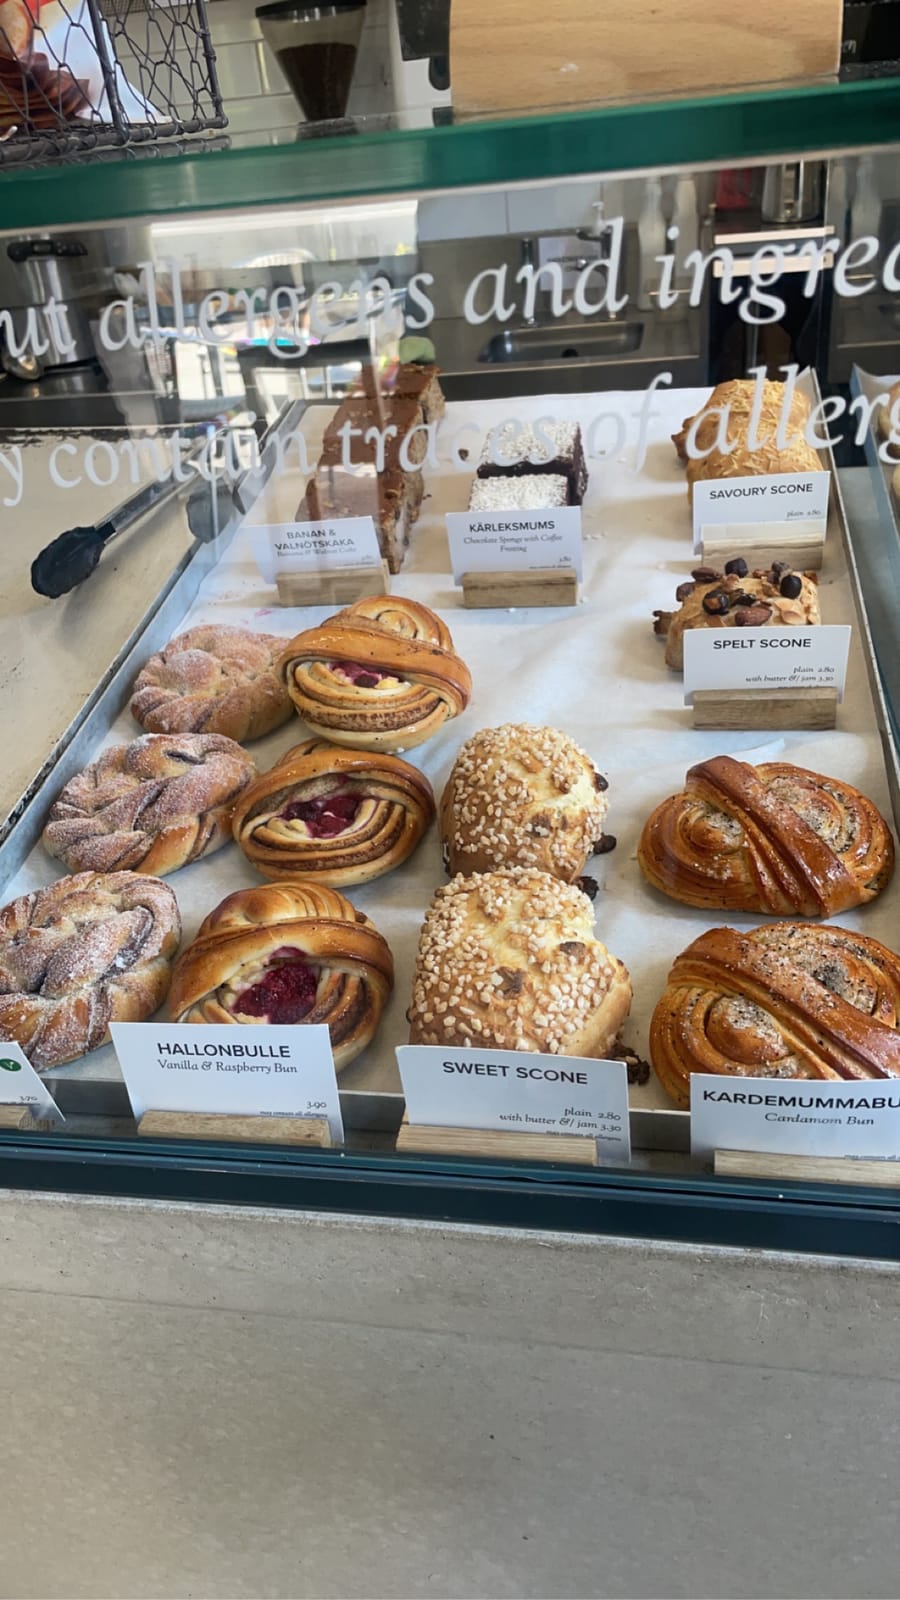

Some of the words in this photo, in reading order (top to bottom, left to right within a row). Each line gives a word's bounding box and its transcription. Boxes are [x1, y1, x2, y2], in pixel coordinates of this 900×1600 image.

[100, 261, 434, 359] allergens
[463, 215, 629, 326] and
[48, 410, 319, 488] contain
[337, 414, 559, 475] traces
[587, 371, 673, 474] of
[709, 486, 767, 500] SAVOURY
[770, 483, 813, 495] SCONE
[286, 529, 326, 540] BANAN
[713, 639, 756, 650] SPELT
[759, 638, 812, 648] SCONE
[764, 674, 787, 682] butter
[793, 666, 814, 674] plain
[157, 1042, 291, 1058] HALLONBULLE
[157, 1059, 199, 1071] Vanilla
[201, 1061, 213, 1071] &
[216, 1061, 271, 1075] Raspberry
[274, 1063, 298, 1073] Bun
[442, 1061, 510, 1077] SWEET
[516, 1067, 588, 1084] SCONE
[306, 1101, 327, 1109] 3.90
[703, 1090, 900, 1109] KARDEMUMMABU
[564, 1107, 592, 1118] plain
[597, 1111, 622, 1121] 2.80
[764, 1112, 843, 1125] Cardamom
[846, 1115, 874, 1126] Bun
[499, 1113, 523, 1123] with
[525, 1114, 557, 1125] butter
[576, 1119, 597, 1129] jam
[600, 1123, 622, 1132] 3.30
